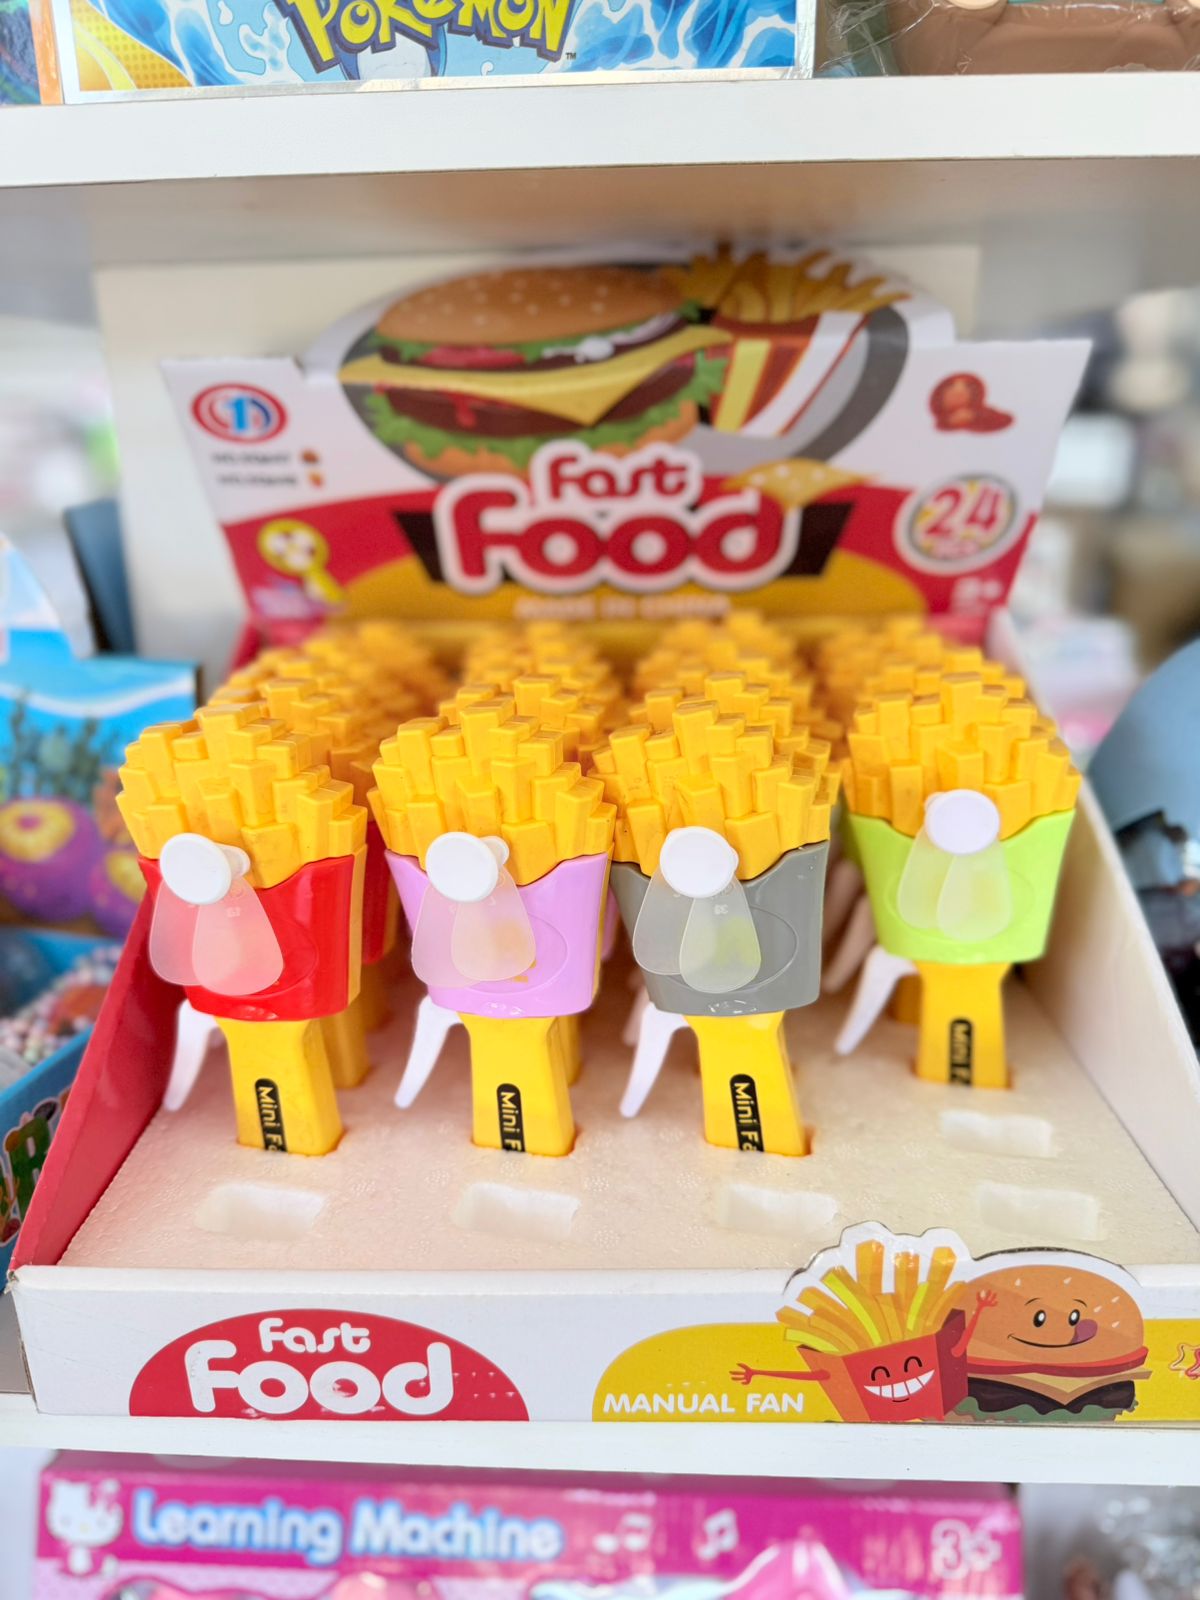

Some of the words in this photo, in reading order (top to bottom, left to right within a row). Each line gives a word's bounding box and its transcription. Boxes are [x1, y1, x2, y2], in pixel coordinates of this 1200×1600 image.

[925, 485, 1002, 535] 24
[258, 1086, 281, 1127] Mini
[500, 1091, 520, 1133] Mini
[734, 1082, 757, 1124] Mini
[258, 1318, 371, 1353] Fast
[603, 1393, 735, 1414] MANUAL
[746, 1393, 804, 1414] FAN
[134, 1490, 343, 1566] Learning
[350, 1499, 564, 1561] Machine
